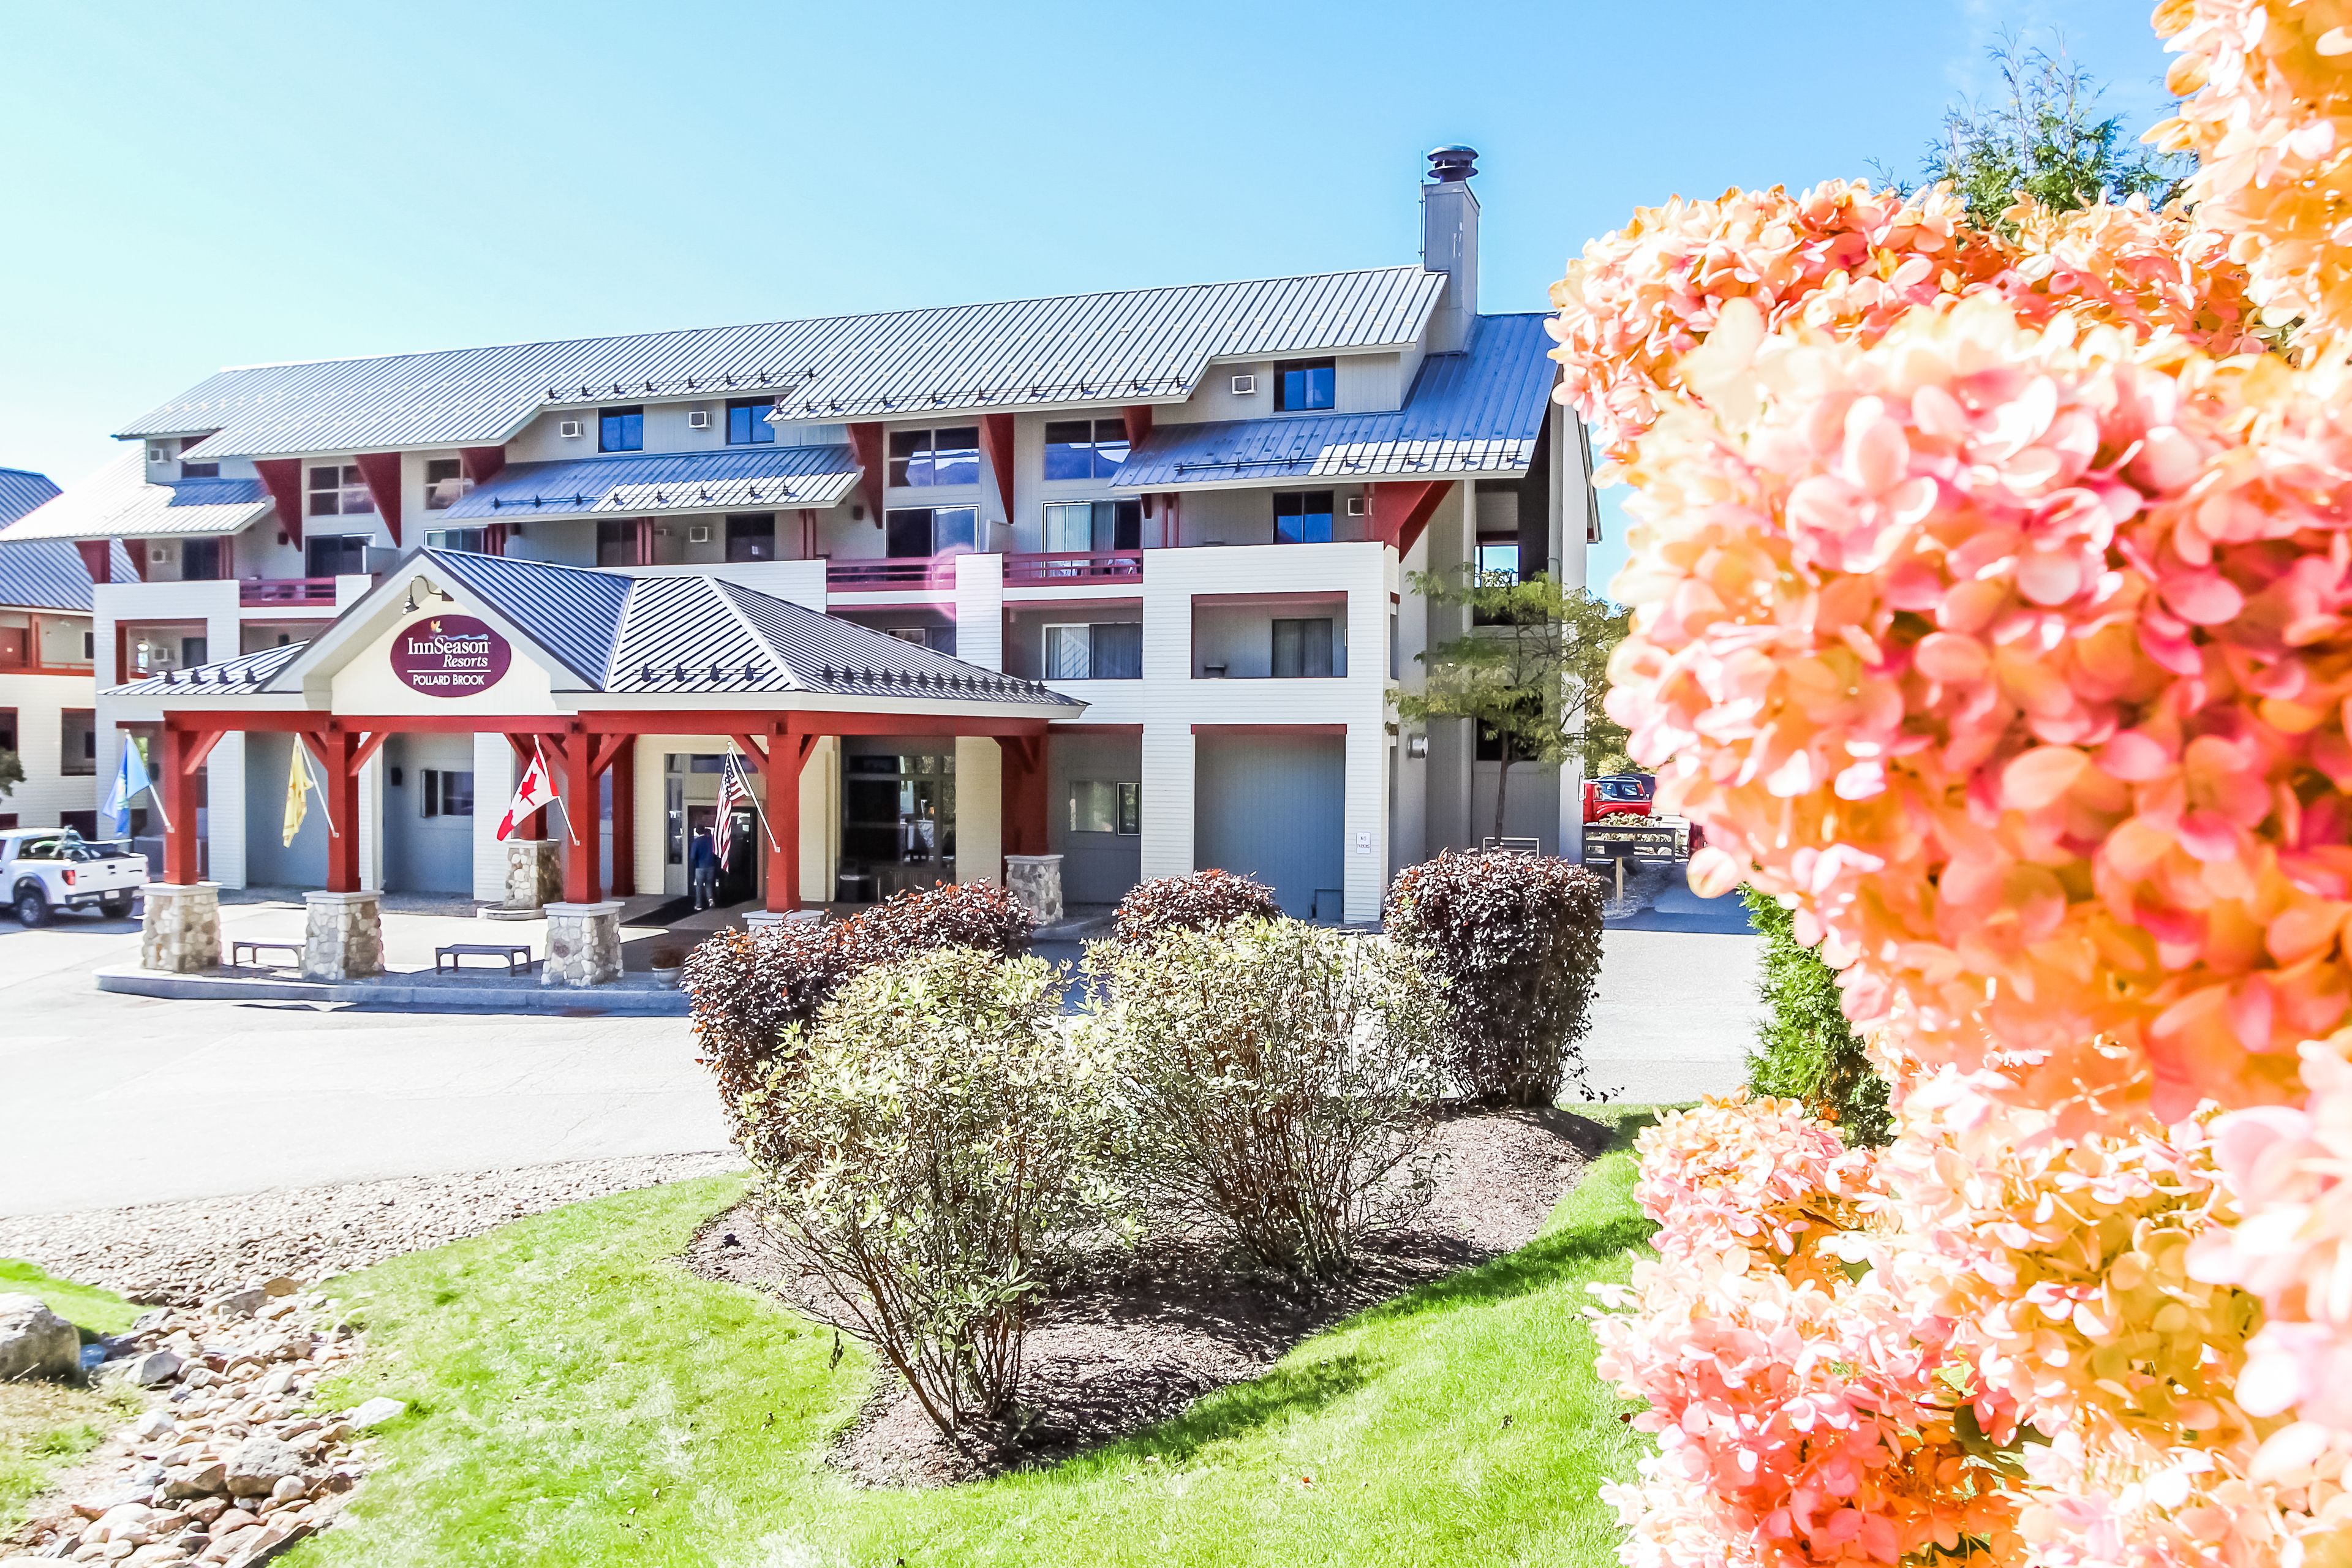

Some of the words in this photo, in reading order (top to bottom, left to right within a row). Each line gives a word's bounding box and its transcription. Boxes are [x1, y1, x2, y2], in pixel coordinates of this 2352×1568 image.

[407, 637, 489, 655] InnSeason
[443, 654, 488, 668] Resorts
[413, 674, 450, 685] POLLARD
[453, 674, 484, 685] BROOK
